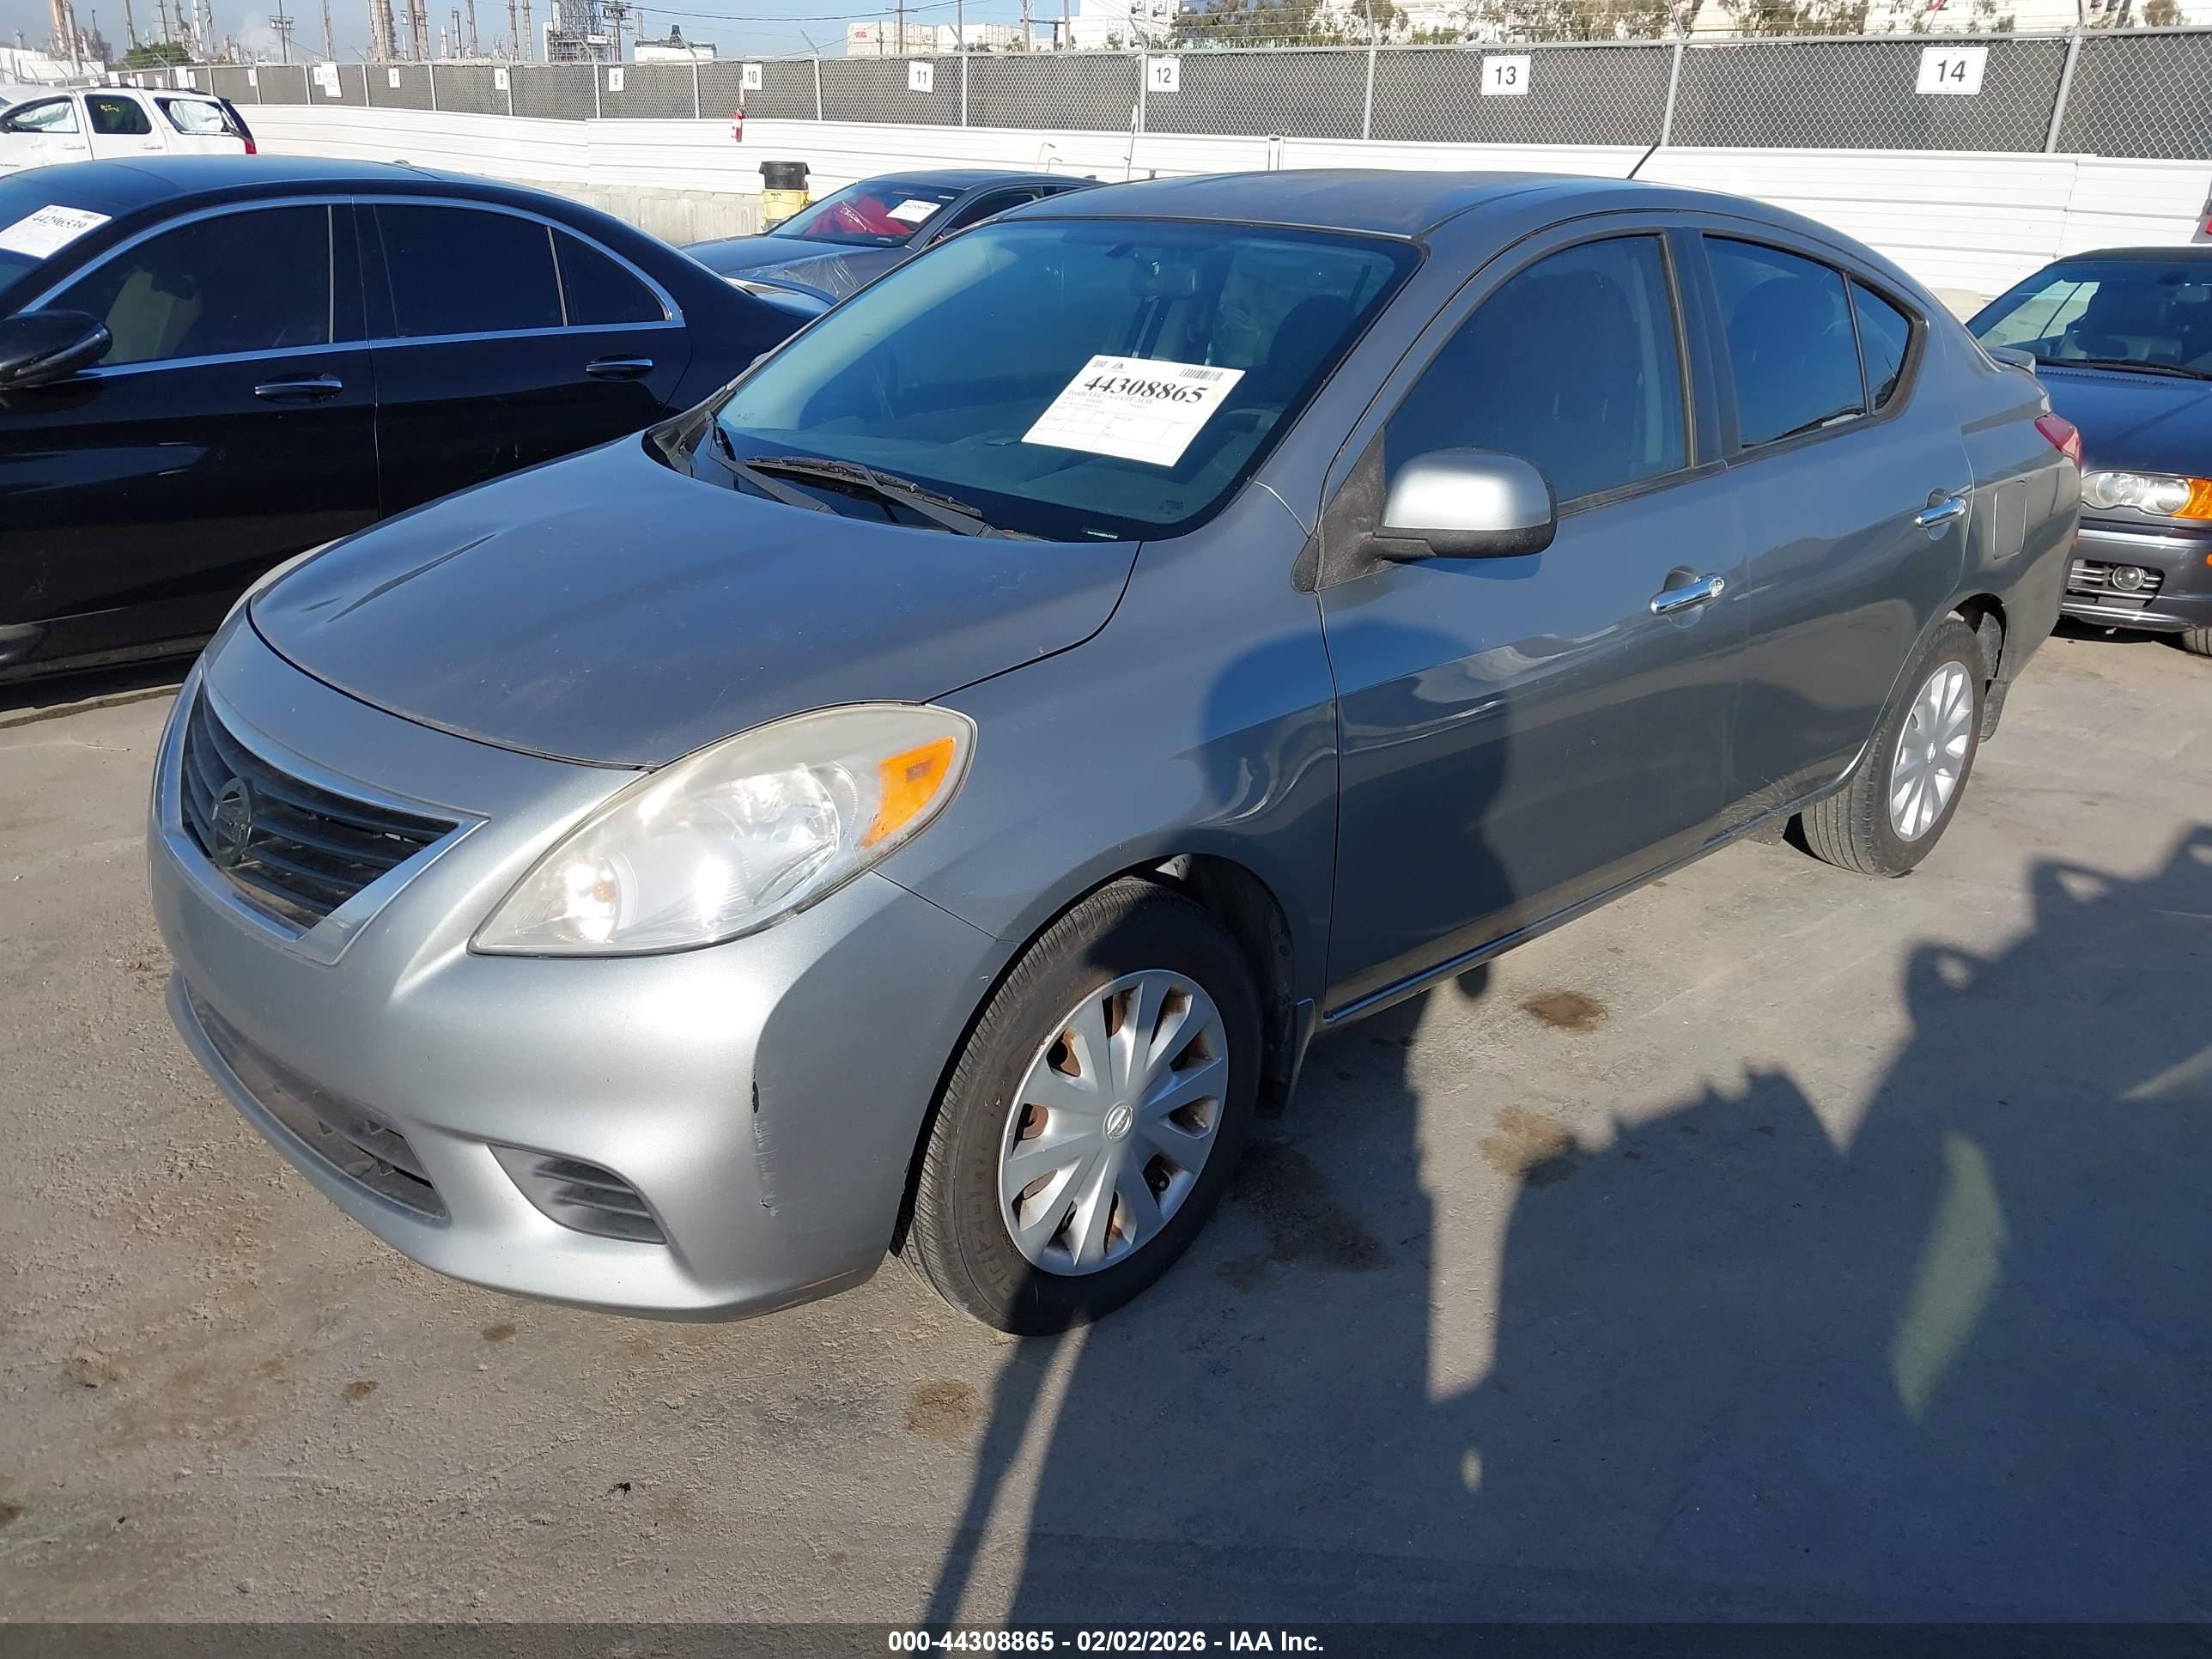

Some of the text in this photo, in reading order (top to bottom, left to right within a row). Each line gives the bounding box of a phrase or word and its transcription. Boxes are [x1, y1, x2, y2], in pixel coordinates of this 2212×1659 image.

[392, 73, 397, 82] 7
[748, 70, 757, 83] 10
[916, 70, 927, 84] 11
[1156, 67, 1171, 83] 12
[1495, 65, 1516, 85] 13
[1937, 59, 1966, 82] 14
[500, 74, 504, 84] 8
[614, 74, 618, 85] 9
[1084, 375, 1209, 404] 44308865
